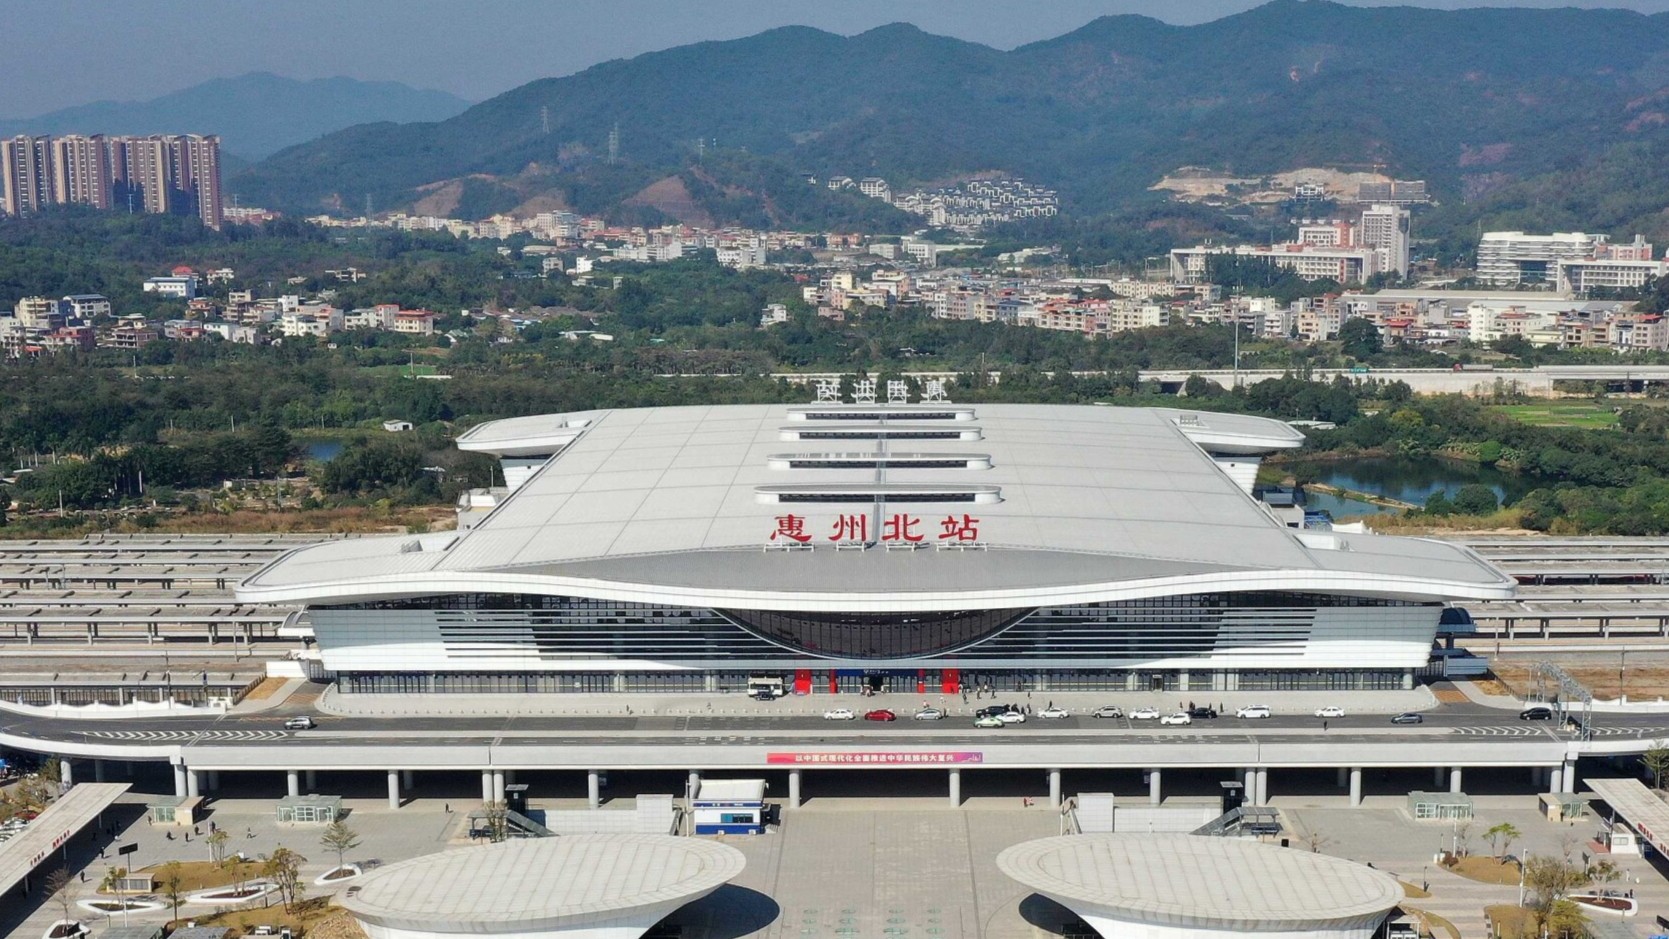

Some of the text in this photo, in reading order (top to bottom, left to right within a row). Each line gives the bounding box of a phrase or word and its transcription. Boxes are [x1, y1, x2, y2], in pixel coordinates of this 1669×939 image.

[770, 514, 980, 542] 惠州北站
[795, 754, 954, 763] 以中国式现代化全面推进中华民族伟大复兴
